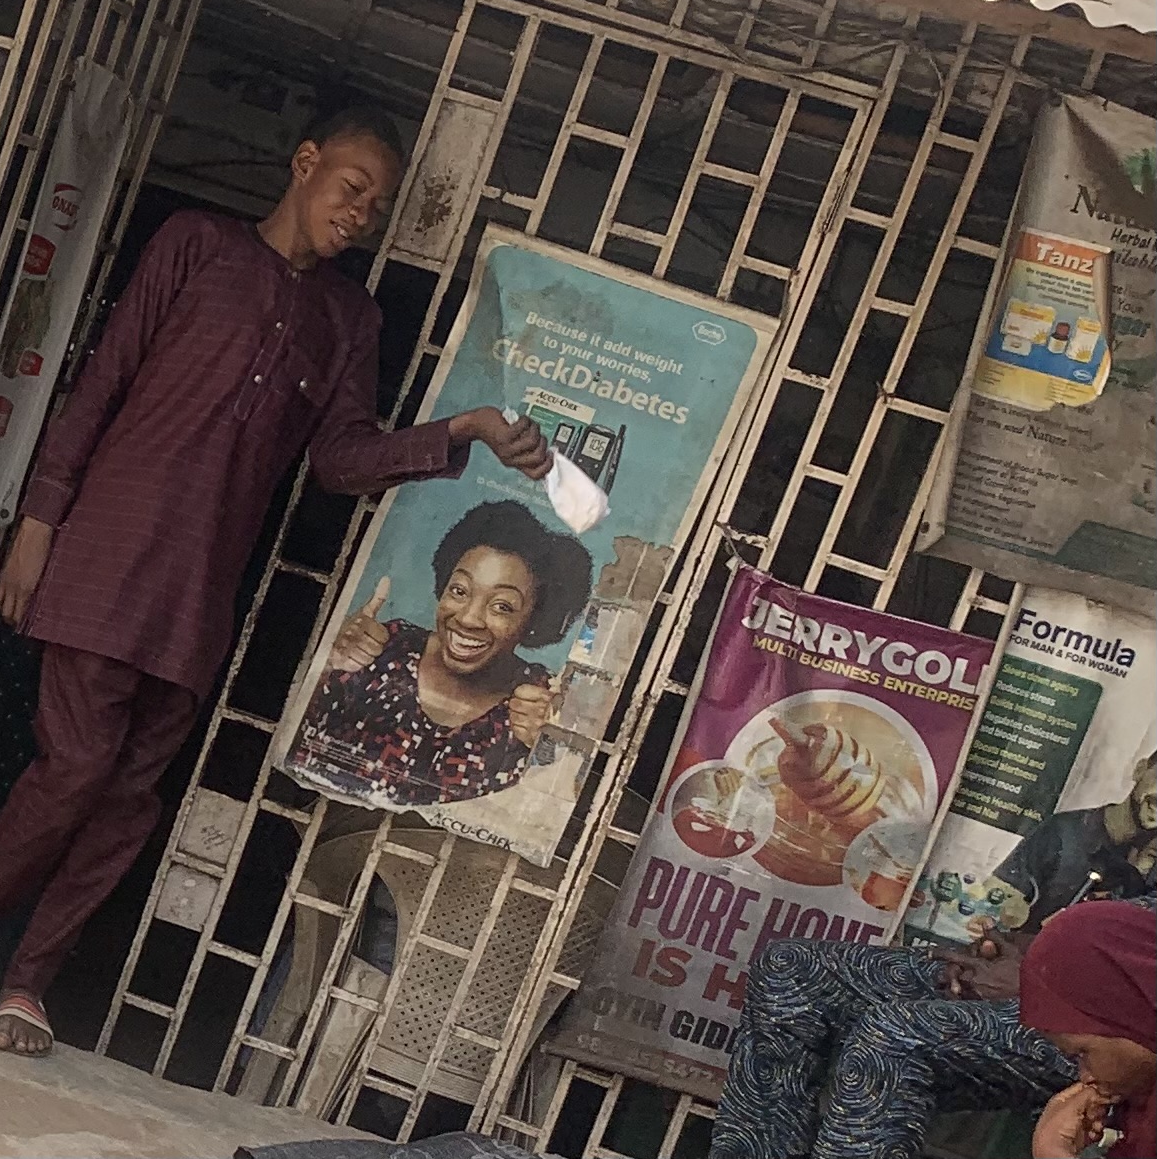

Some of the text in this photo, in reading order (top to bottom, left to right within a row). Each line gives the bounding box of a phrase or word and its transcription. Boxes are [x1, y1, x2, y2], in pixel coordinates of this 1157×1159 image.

[1036, 242, 1093, 273] Tanz
[525, 311, 684, 376] Because it add weight
[542, 335, 652, 384] to your worries,
[492, 338, 690, 424] CheckDiabetes
[753, 634, 796, 660] MULTI
[799, 647, 881, 685] BUSINESS
[1009, 633, 1128, 679] FOR MAN & FOR WOMAN
[1013, 607, 1136, 668] Formula
[628, 856, 760, 961] PURE
[632, 939, 692, 987] IS
